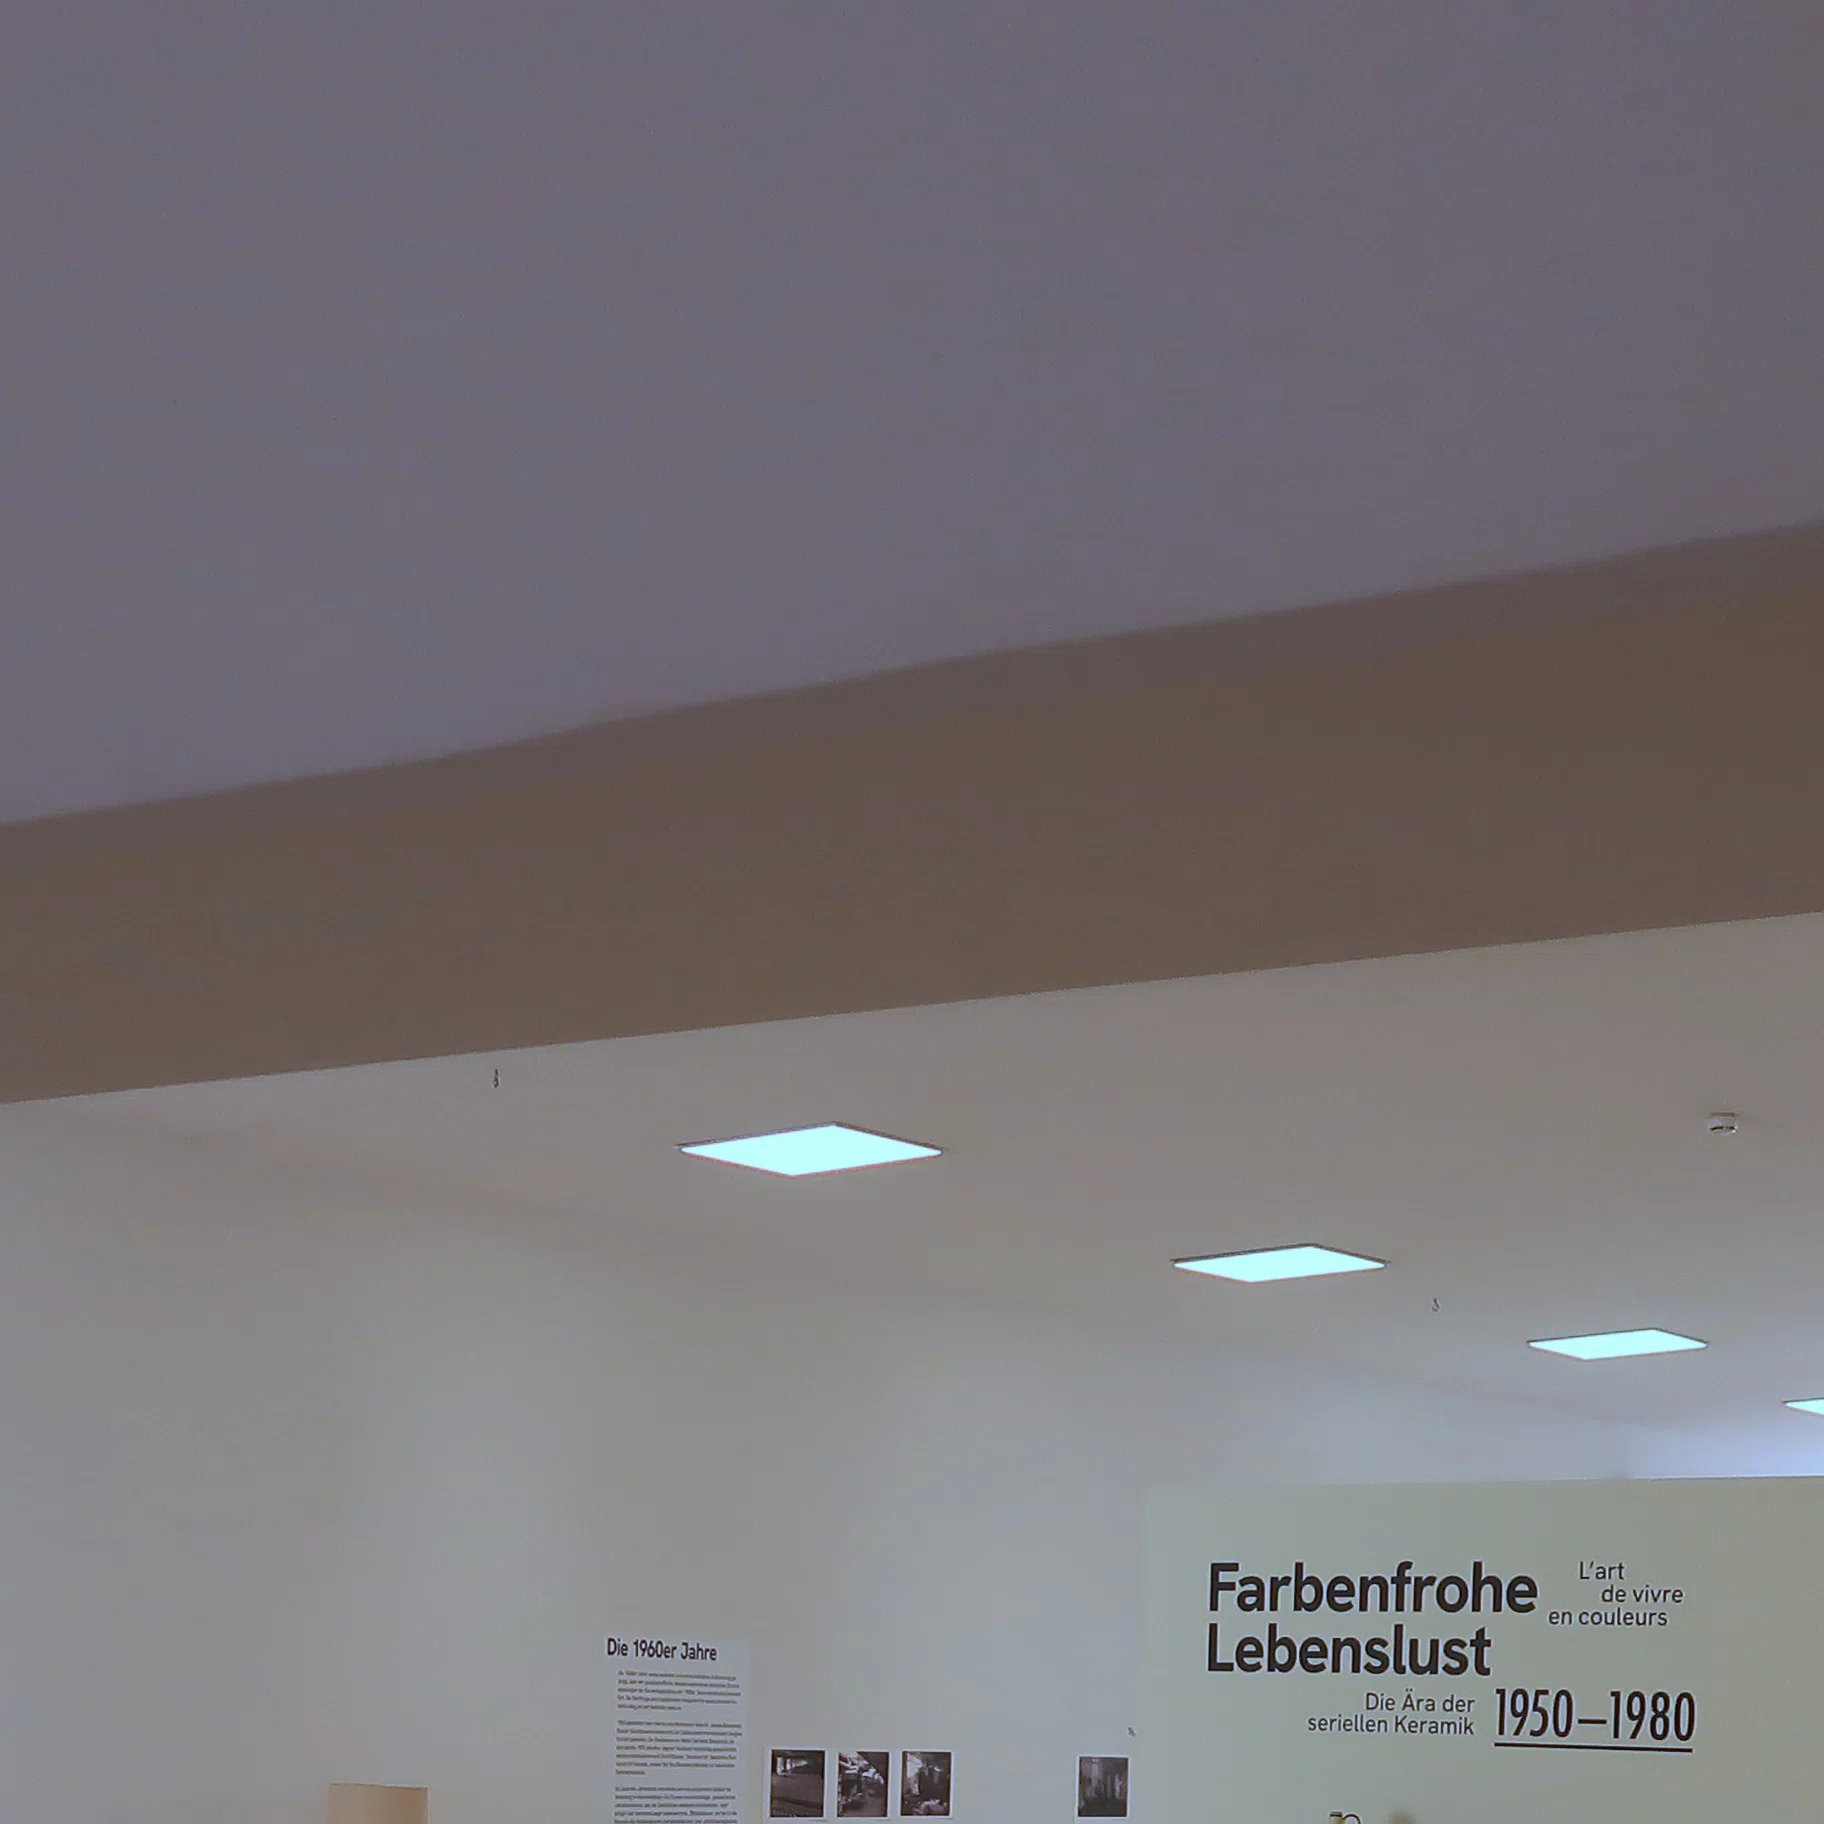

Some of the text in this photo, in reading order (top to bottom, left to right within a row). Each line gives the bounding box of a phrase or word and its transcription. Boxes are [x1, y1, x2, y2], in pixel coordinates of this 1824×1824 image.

[1209, 1560, 1538, 1614] Farbenfrohe
[1601, 1584, 1684, 1604] de vivre
[1548, 1606, 1668, 1627] en couleurs
[607, 1637, 717, 1661] Die 1960er Jahre
[1207, 1622, 1492, 1677] Lebenslust
[1365, 1688, 1476, 1713] Die Ära der
[1307, 1713, 1474, 1736] seriellen Keramik
